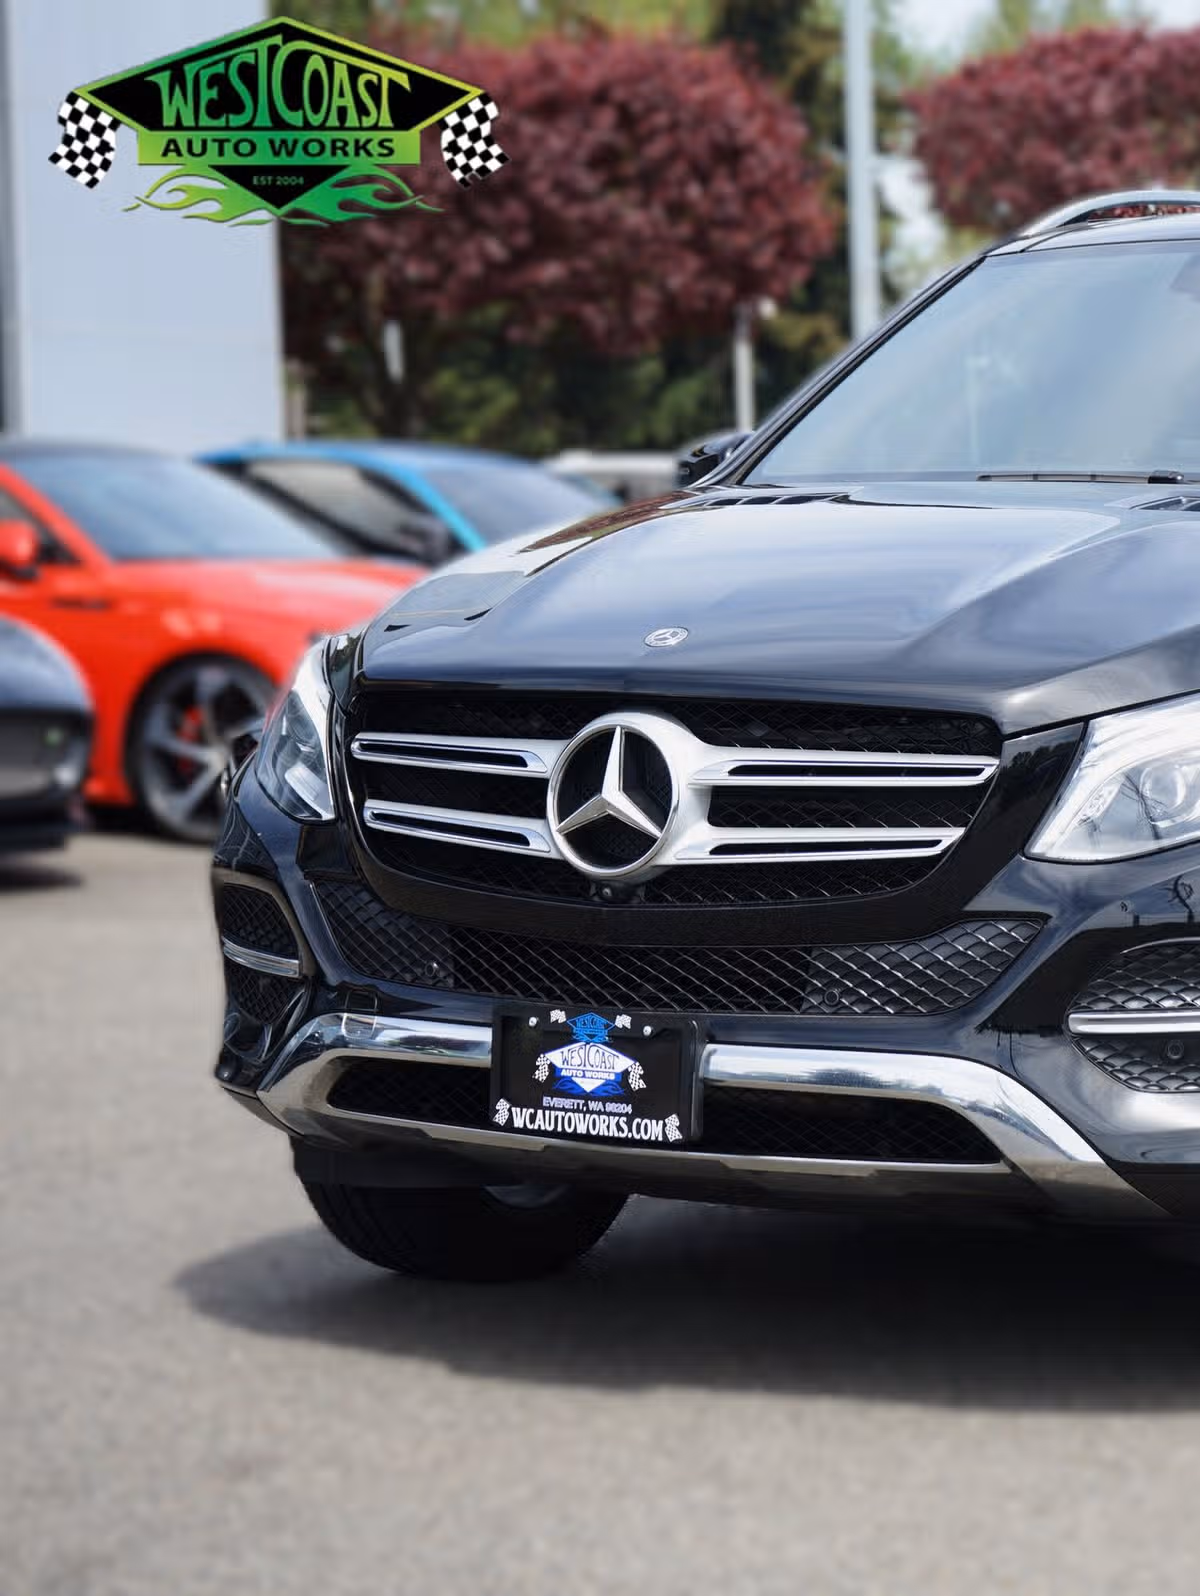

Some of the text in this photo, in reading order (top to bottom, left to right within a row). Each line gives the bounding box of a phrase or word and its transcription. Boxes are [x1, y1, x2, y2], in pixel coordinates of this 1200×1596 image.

[560, 1069, 616, 1080] AUTO WORKS
[542, 1096, 587, 1111] EVERETT,
[588, 1100, 604, 1112] WA
[511, 1107, 664, 1141] WCAUTOWORKS.COM
